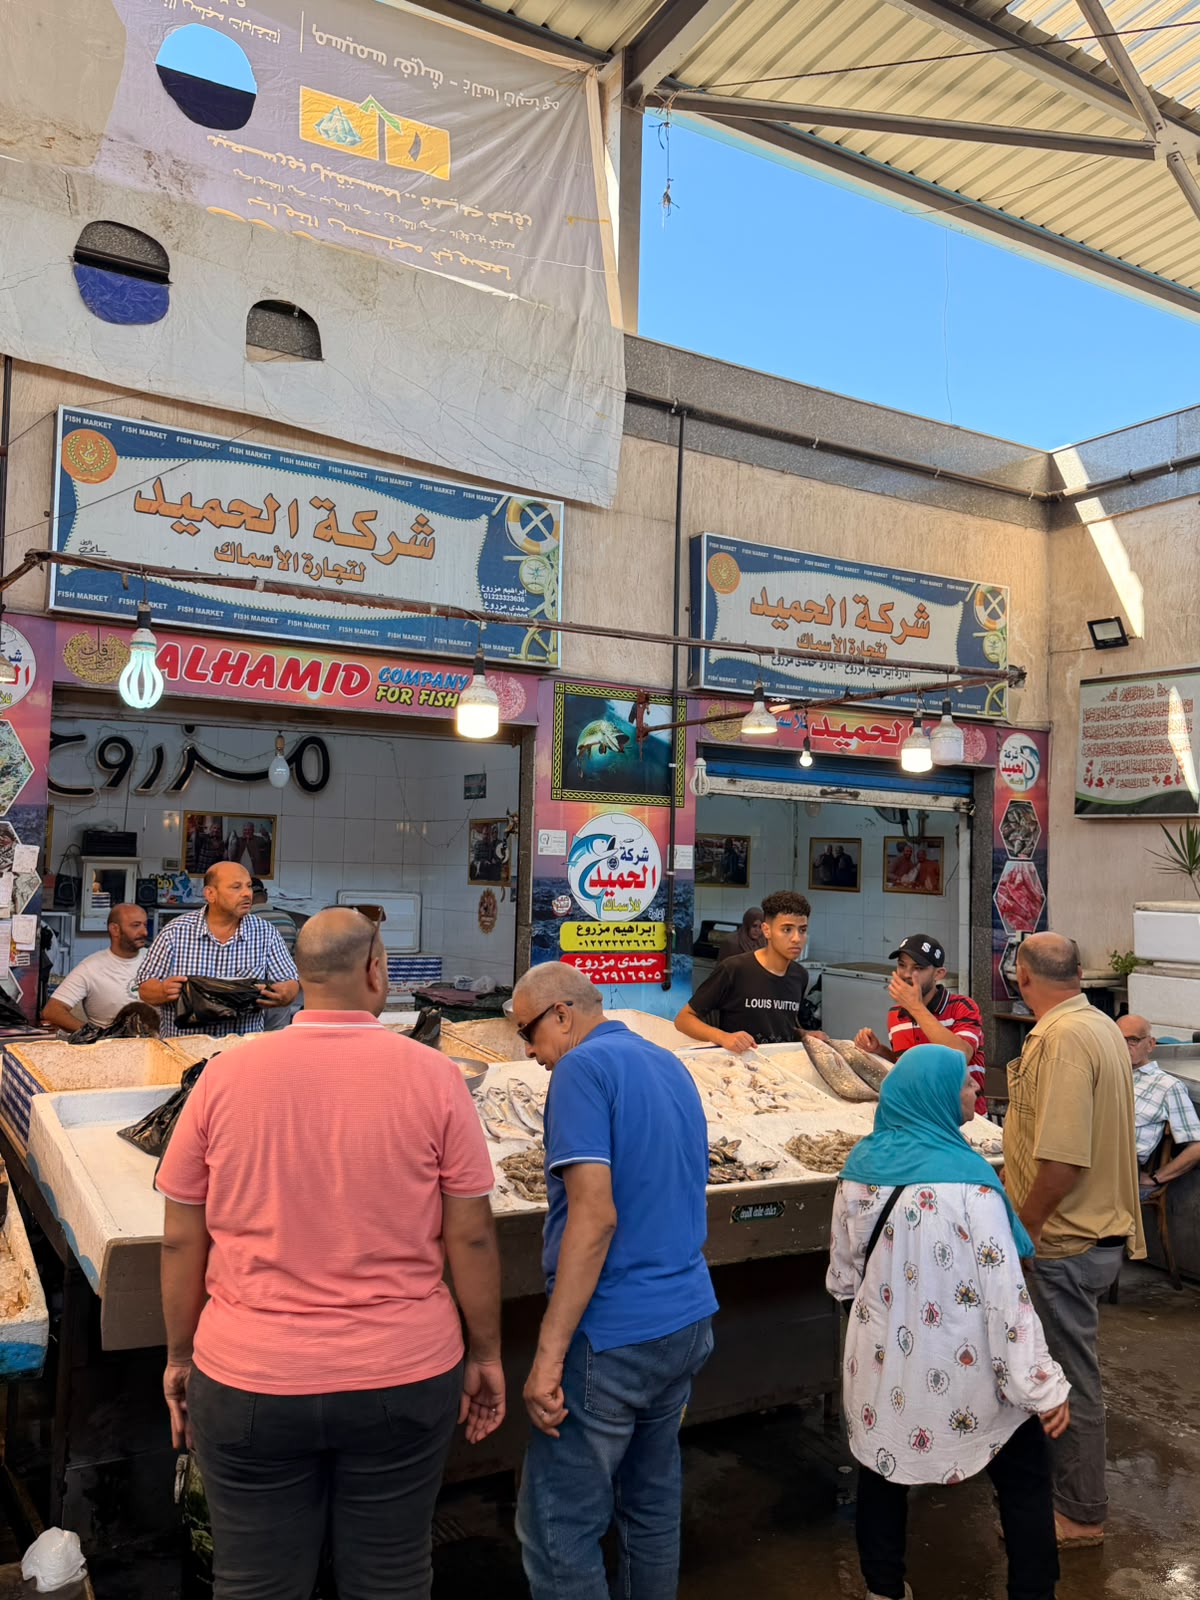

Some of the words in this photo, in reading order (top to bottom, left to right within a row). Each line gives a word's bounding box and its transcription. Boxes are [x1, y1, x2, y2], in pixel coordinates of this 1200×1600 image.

[65, 414, 81, 423] FISH
[83, 418, 112, 430] MARKET
[122, 425, 137, 434] FISH
[139, 428, 167, 440] MARKET
[176, 435, 191, 444] FISH
[193, 439, 220, 450] MARKET
[229, 446, 244, 455] FISH
[245, 449, 271, 460] MARKET
[280, 456, 294, 465] FISH
[296, 459, 320, 470] MARKET
[328, 466, 342, 474] FISH
[344, 468, 367, 479] MARKET
[375, 475, 388, 483] FISH
[390, 477, 412, 487] MARKET
[420, 483, 432, 491] FISH
[434, 485, 456, 496] MARKET
[463, 491, 475, 499] FISH
[476, 493, 498, 503] MARKET
[134, 477, 299, 539] الحميد
[309, 496, 436, 565] شركة
[213, 541, 299, 573] الأسماك
[302, 553, 366, 584] لتجارة
[481, 584, 501, 593] مزروع
[57, 590, 74, 598] FISH
[77, 593, 108, 603] MARKET
[119, 597, 136, 606] FISH
[177, 605, 193, 613] FISH
[195, 607, 224, 617] MARKET
[234, 612, 250, 620] FISH
[251, 614, 278, 624] MARKET
[287, 619, 302, 627] FISH
[304, 621, 330, 630] MARKET
[354, 628, 379, 637] MARKET
[402, 633, 426, 642] MARKET
[449, 638, 472, 647] MARKET
[483, 601, 507, 610] مزروع
[749, 586, 846, 630] الحميد
[853, 593, 930, 644] شركة
[796, 632, 847, 655] الأسماك
[847, 638, 888, 659] لتجارة
[156, 642, 372, 698] ALHAMID
[378, 666, 469, 691] COMPANY
[376, 685, 413, 706] FOR
[418, 687, 460, 709] FISH
[48, 724, 330, 797] مزروع
[620, 847, 650, 865] شركة
[589, 864, 656, 897] الحميد
[576, 923, 610, 936] مزروع
[575, 956, 615, 970] مزروع
[745, 998, 772, 1009] LOUIS
